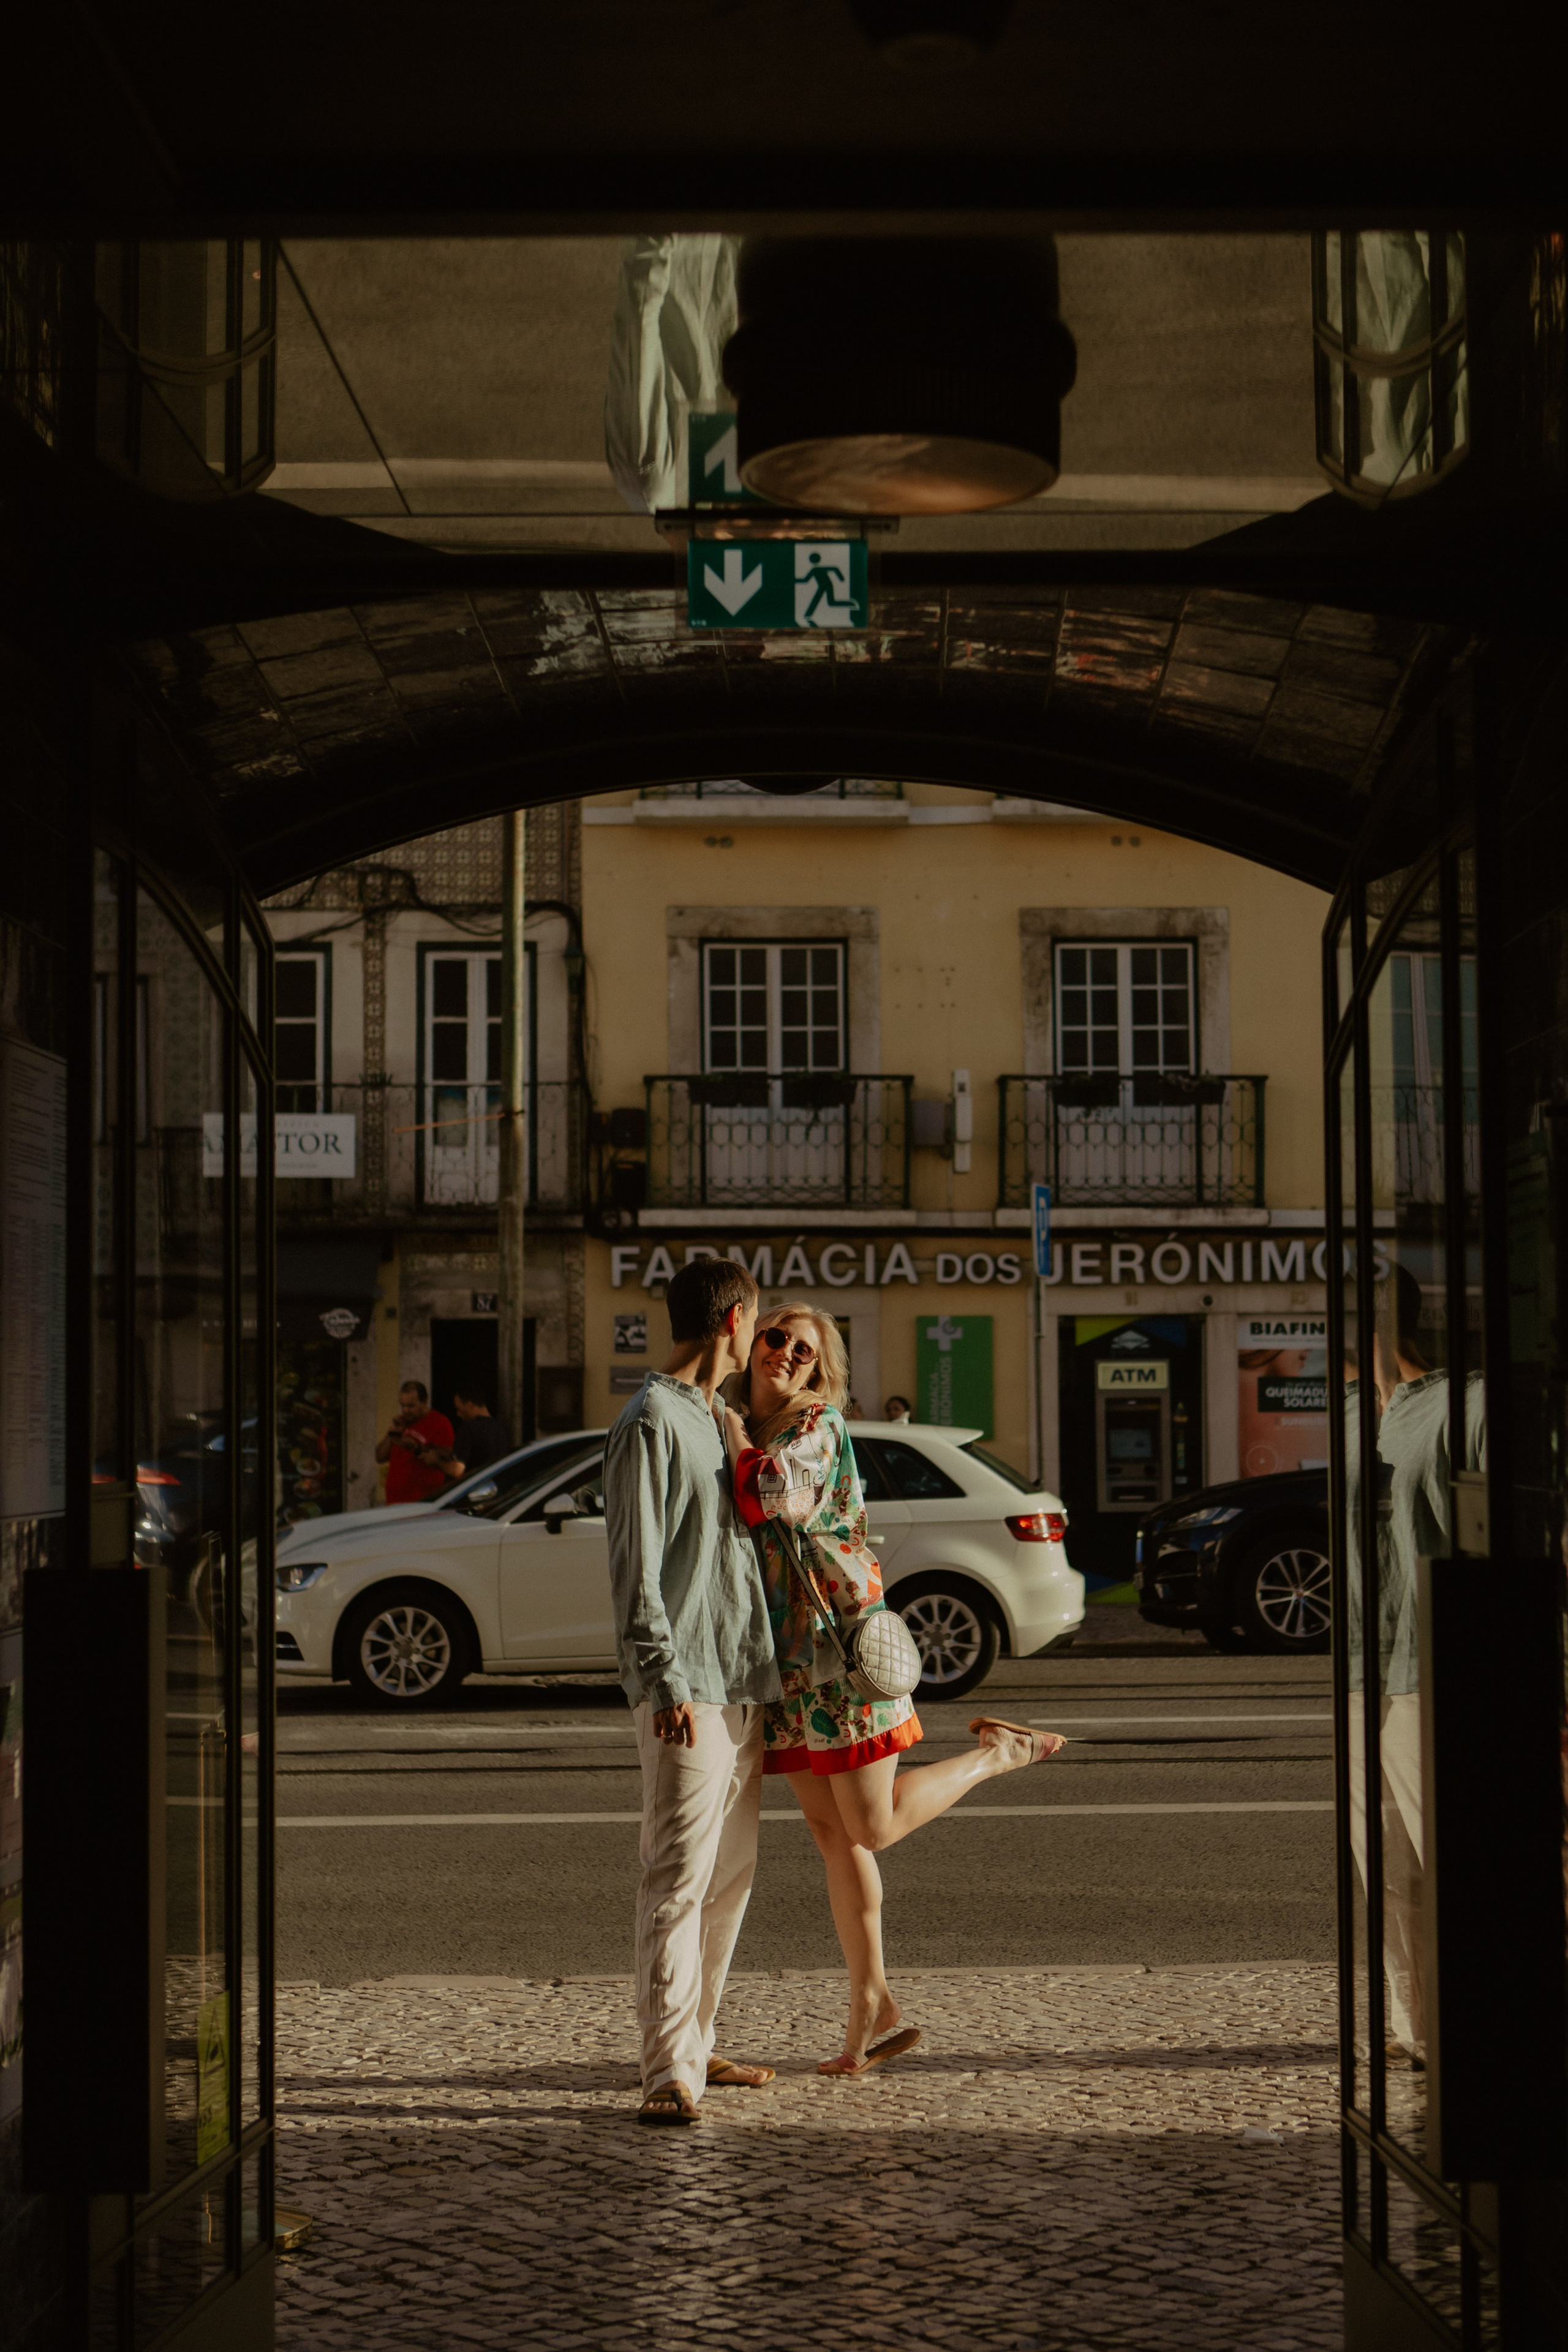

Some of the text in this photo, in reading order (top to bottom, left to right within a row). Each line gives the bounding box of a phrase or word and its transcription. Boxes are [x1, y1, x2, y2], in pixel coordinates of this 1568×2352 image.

[936, 1253, 1022, 1284] DOS
[1250, 1322, 1325, 1335] BIAFIN
[1110, 1368, 1156, 1382] ATM
